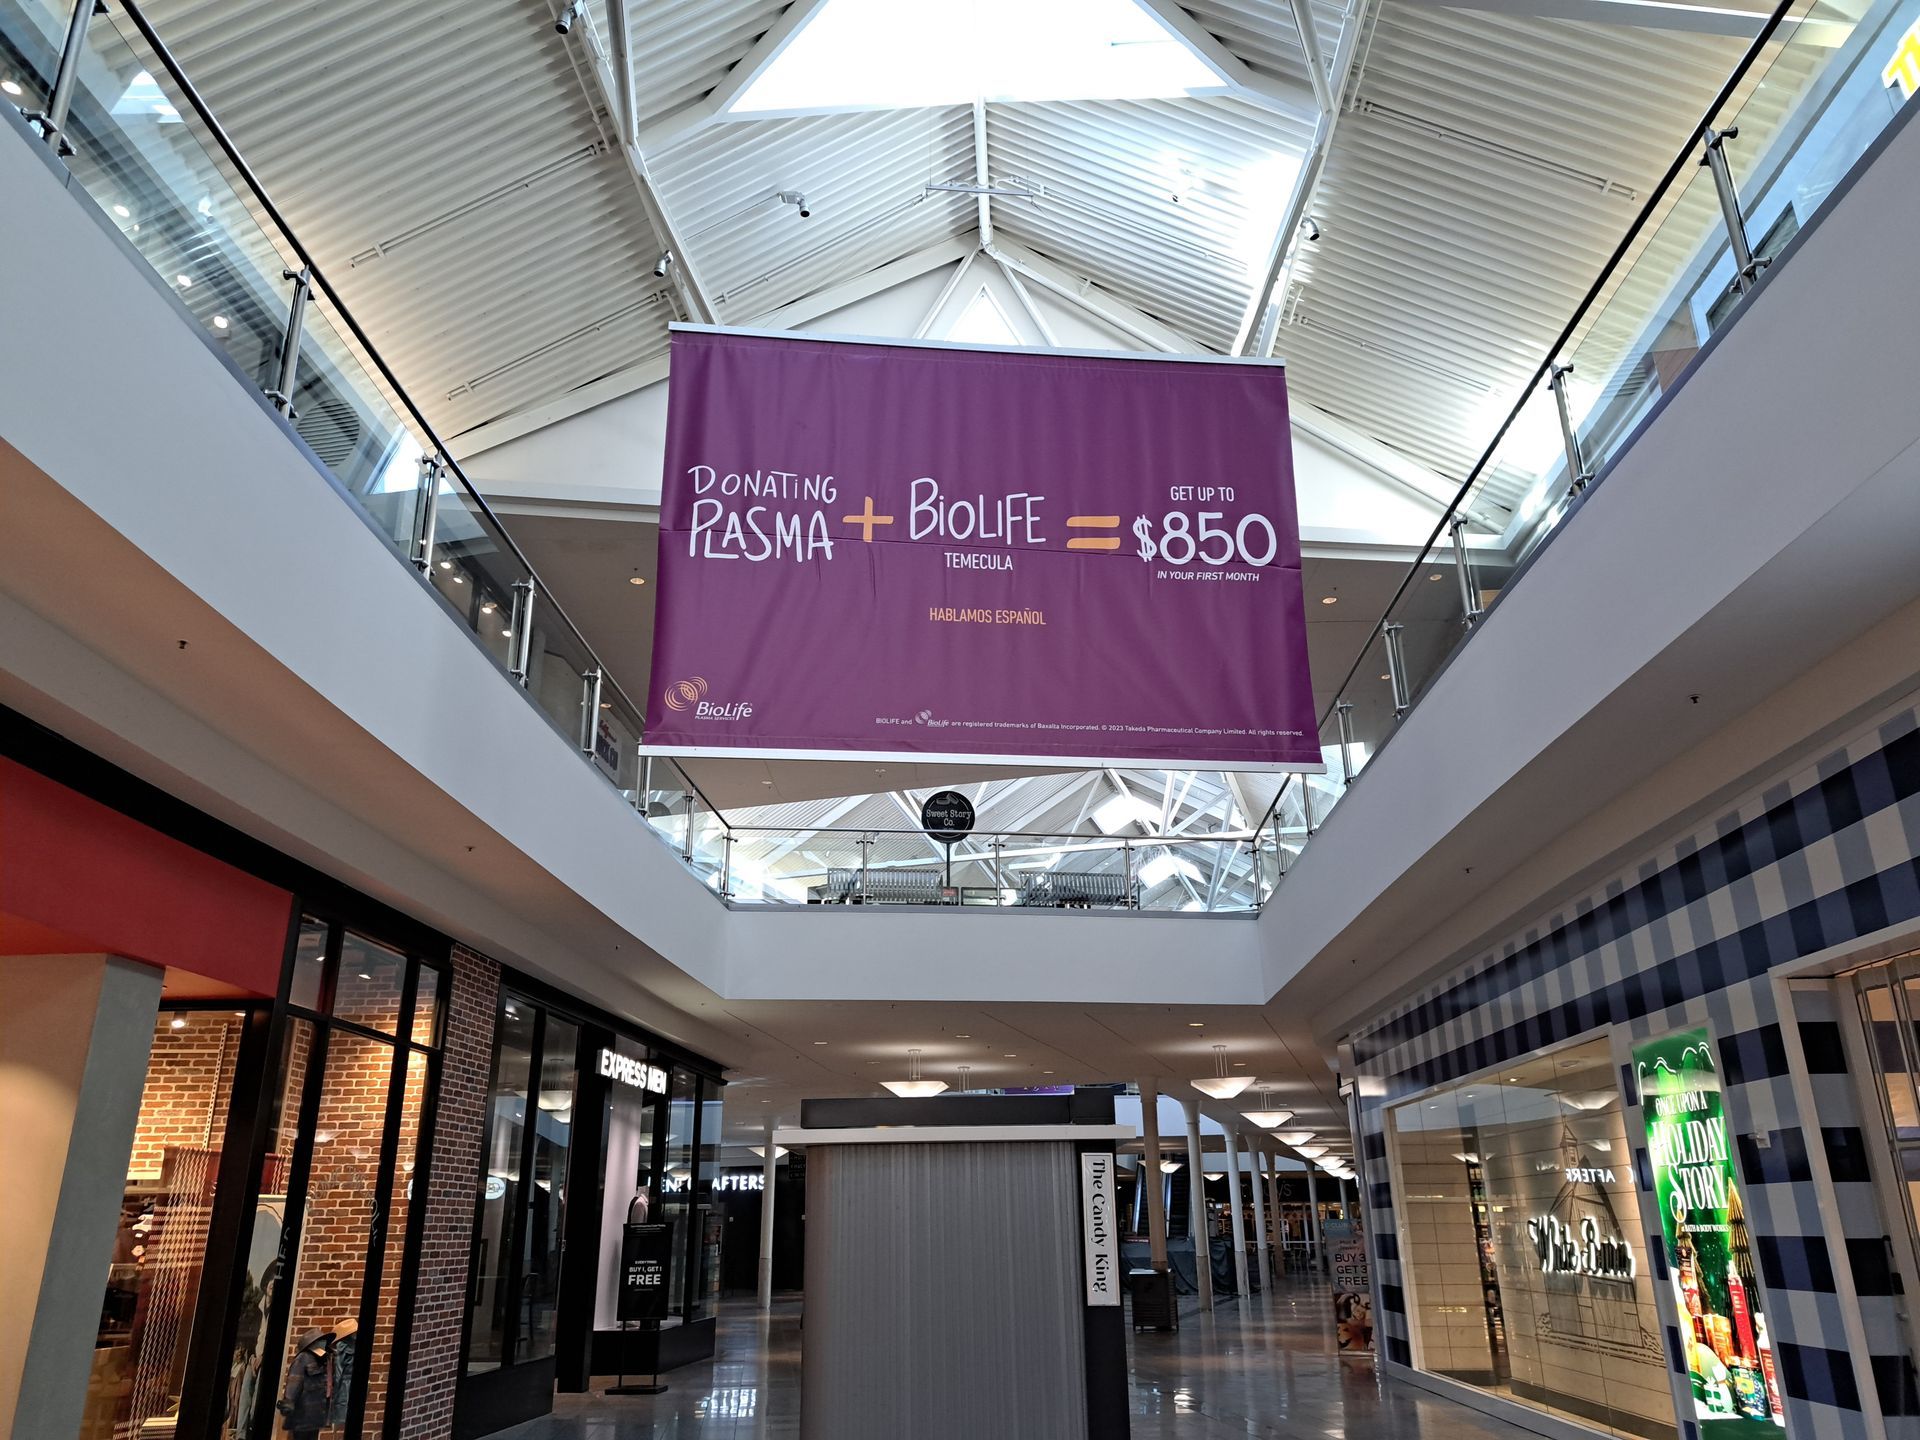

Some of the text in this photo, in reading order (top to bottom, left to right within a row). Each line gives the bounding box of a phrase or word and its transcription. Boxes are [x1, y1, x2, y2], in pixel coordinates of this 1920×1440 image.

[1170, 486, 1235, 502] GET UP TO
[689, 498, 834, 562] PLASMA
[1132, 511, 1278, 567] $850
[944, 552, 1013, 571] TEMECULA
[1157, 570, 1260, 582] IN YOUR FIRST MONTH
[929, 607, 1046, 626] HABLAMOS ESPAÑOL
[696, 701, 753, 721] BioLife
[875, 717, 900, 725] BIOLIFE
[962, 720, 993, 729] registered
[994, 721, 1029, 729] trademarks
[1061, 723, 1099, 732] Incorporated.
[1147, 726, 1193, 734] Pharmaceutical
[1194, 727, 1222, 736] Company
[1257, 729, 1275, 737] rights
[926, 809, 972, 820] Sweet Story
[943, 818, 955, 827] Co.
[601, 1048, 667, 1095] EXPRESS MEN
[1655, 1089, 1708, 1117] ONCE UPON A
[1651, 1116, 1728, 1167] HOLIDAY
[1668, 1164, 1728, 1223] STORY
[1091, 1159, 1108, 1293] The Candy King
[1527, 1214, 1580, 1274] White
[1335, 1253, 1366, 1262] BUY 3
[1336, 1265, 1367, 1274] GET 3
[628, 1273, 661, 1286] FREE
[1337, 1276, 1369, 1286] FREE
